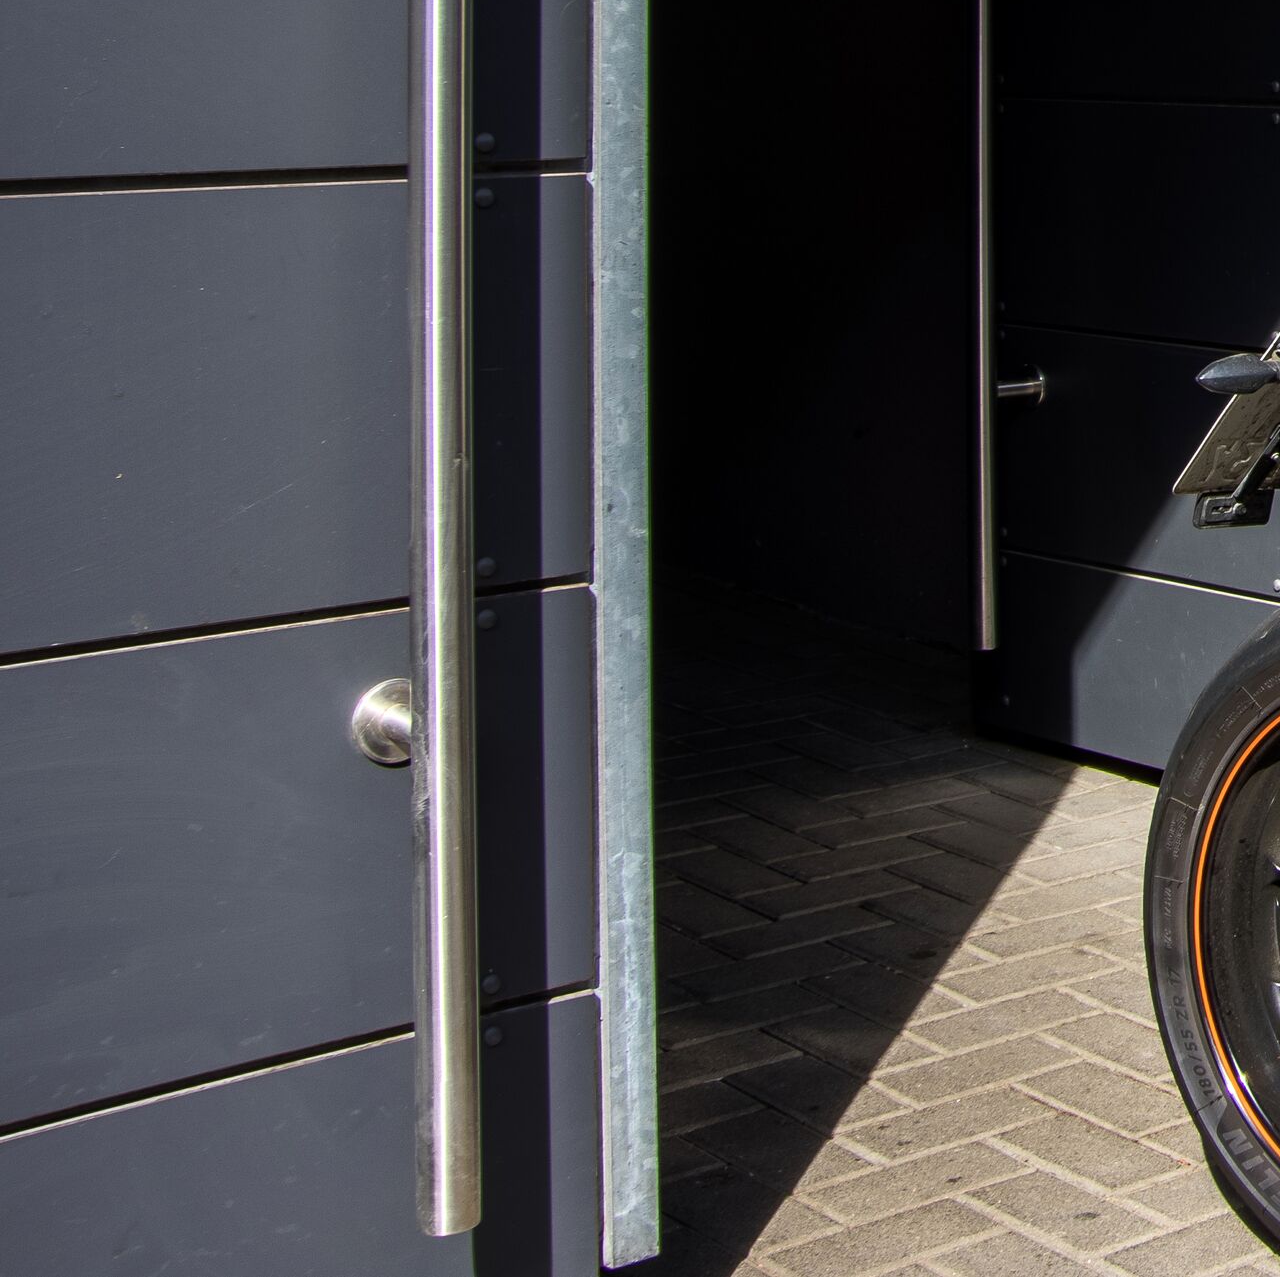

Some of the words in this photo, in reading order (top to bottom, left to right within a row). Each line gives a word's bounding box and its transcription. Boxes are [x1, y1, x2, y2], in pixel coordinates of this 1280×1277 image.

[1167, 970, 1181, 987] 17
[1174, 995, 1190, 1021] ZR
[1179, 1030, 1215, 1099] 180/55
